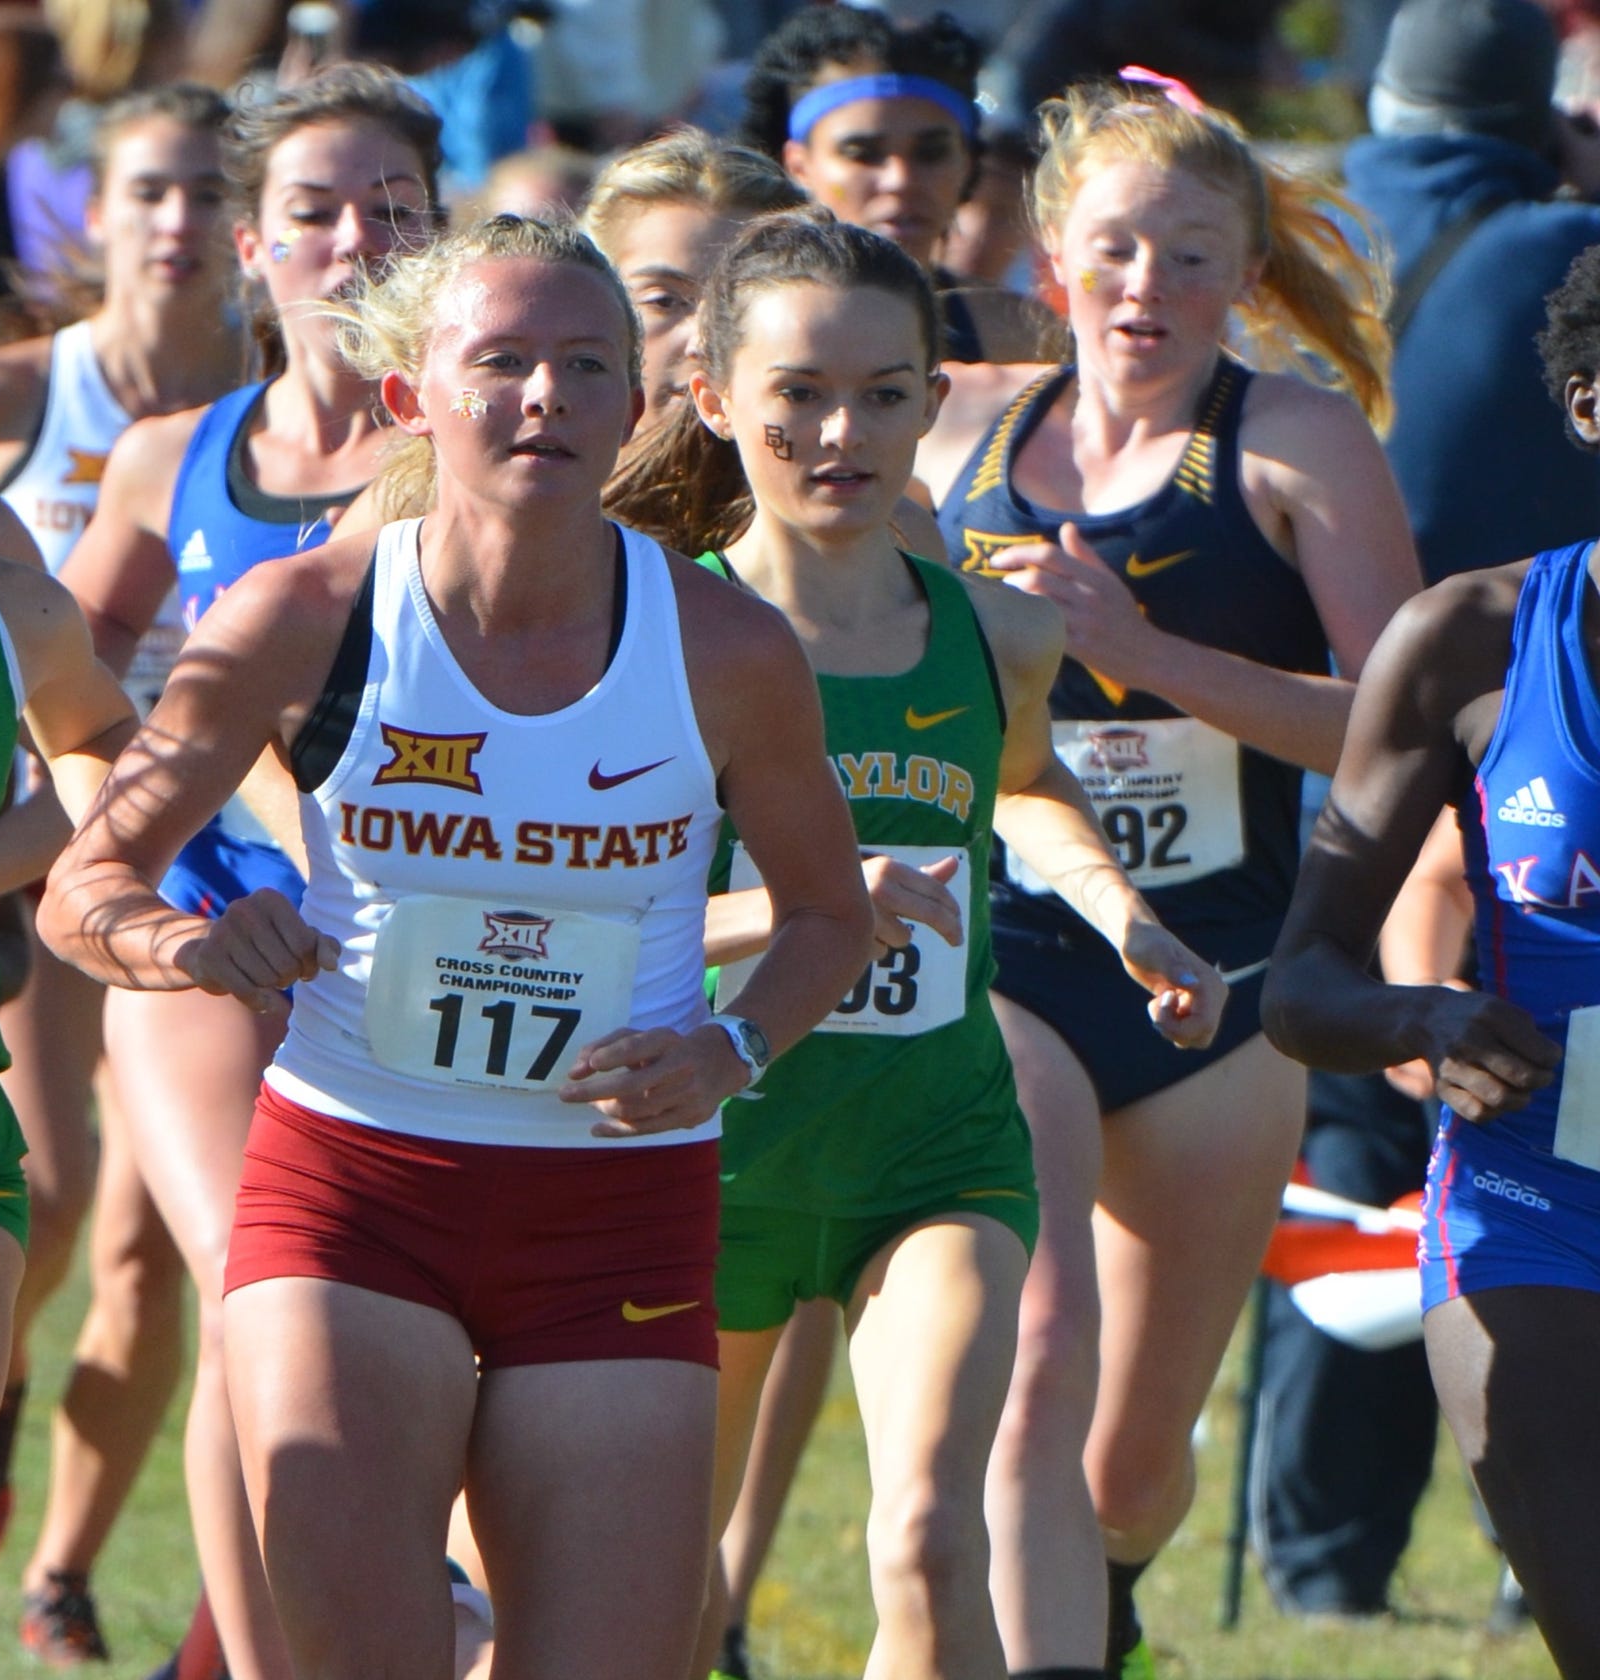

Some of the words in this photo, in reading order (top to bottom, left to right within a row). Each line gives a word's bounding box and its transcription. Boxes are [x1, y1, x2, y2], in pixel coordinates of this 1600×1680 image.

[763, 424, 792, 461] BU
[371, 722, 488, 795] XII
[827, 752, 974, 824] YLOR
[339, 802, 503, 861] IOWA
[515, 813, 694, 869] STATE
[1497, 805, 1567, 828] adidas
[436, 957, 495, 975] CROSS
[500, 964, 584, 985] COUNTRY
[439, 974, 576, 1001] CHAMPIONSHIP
[429, 993, 582, 1082] 117
[1472, 1174, 1551, 1212] adidas
